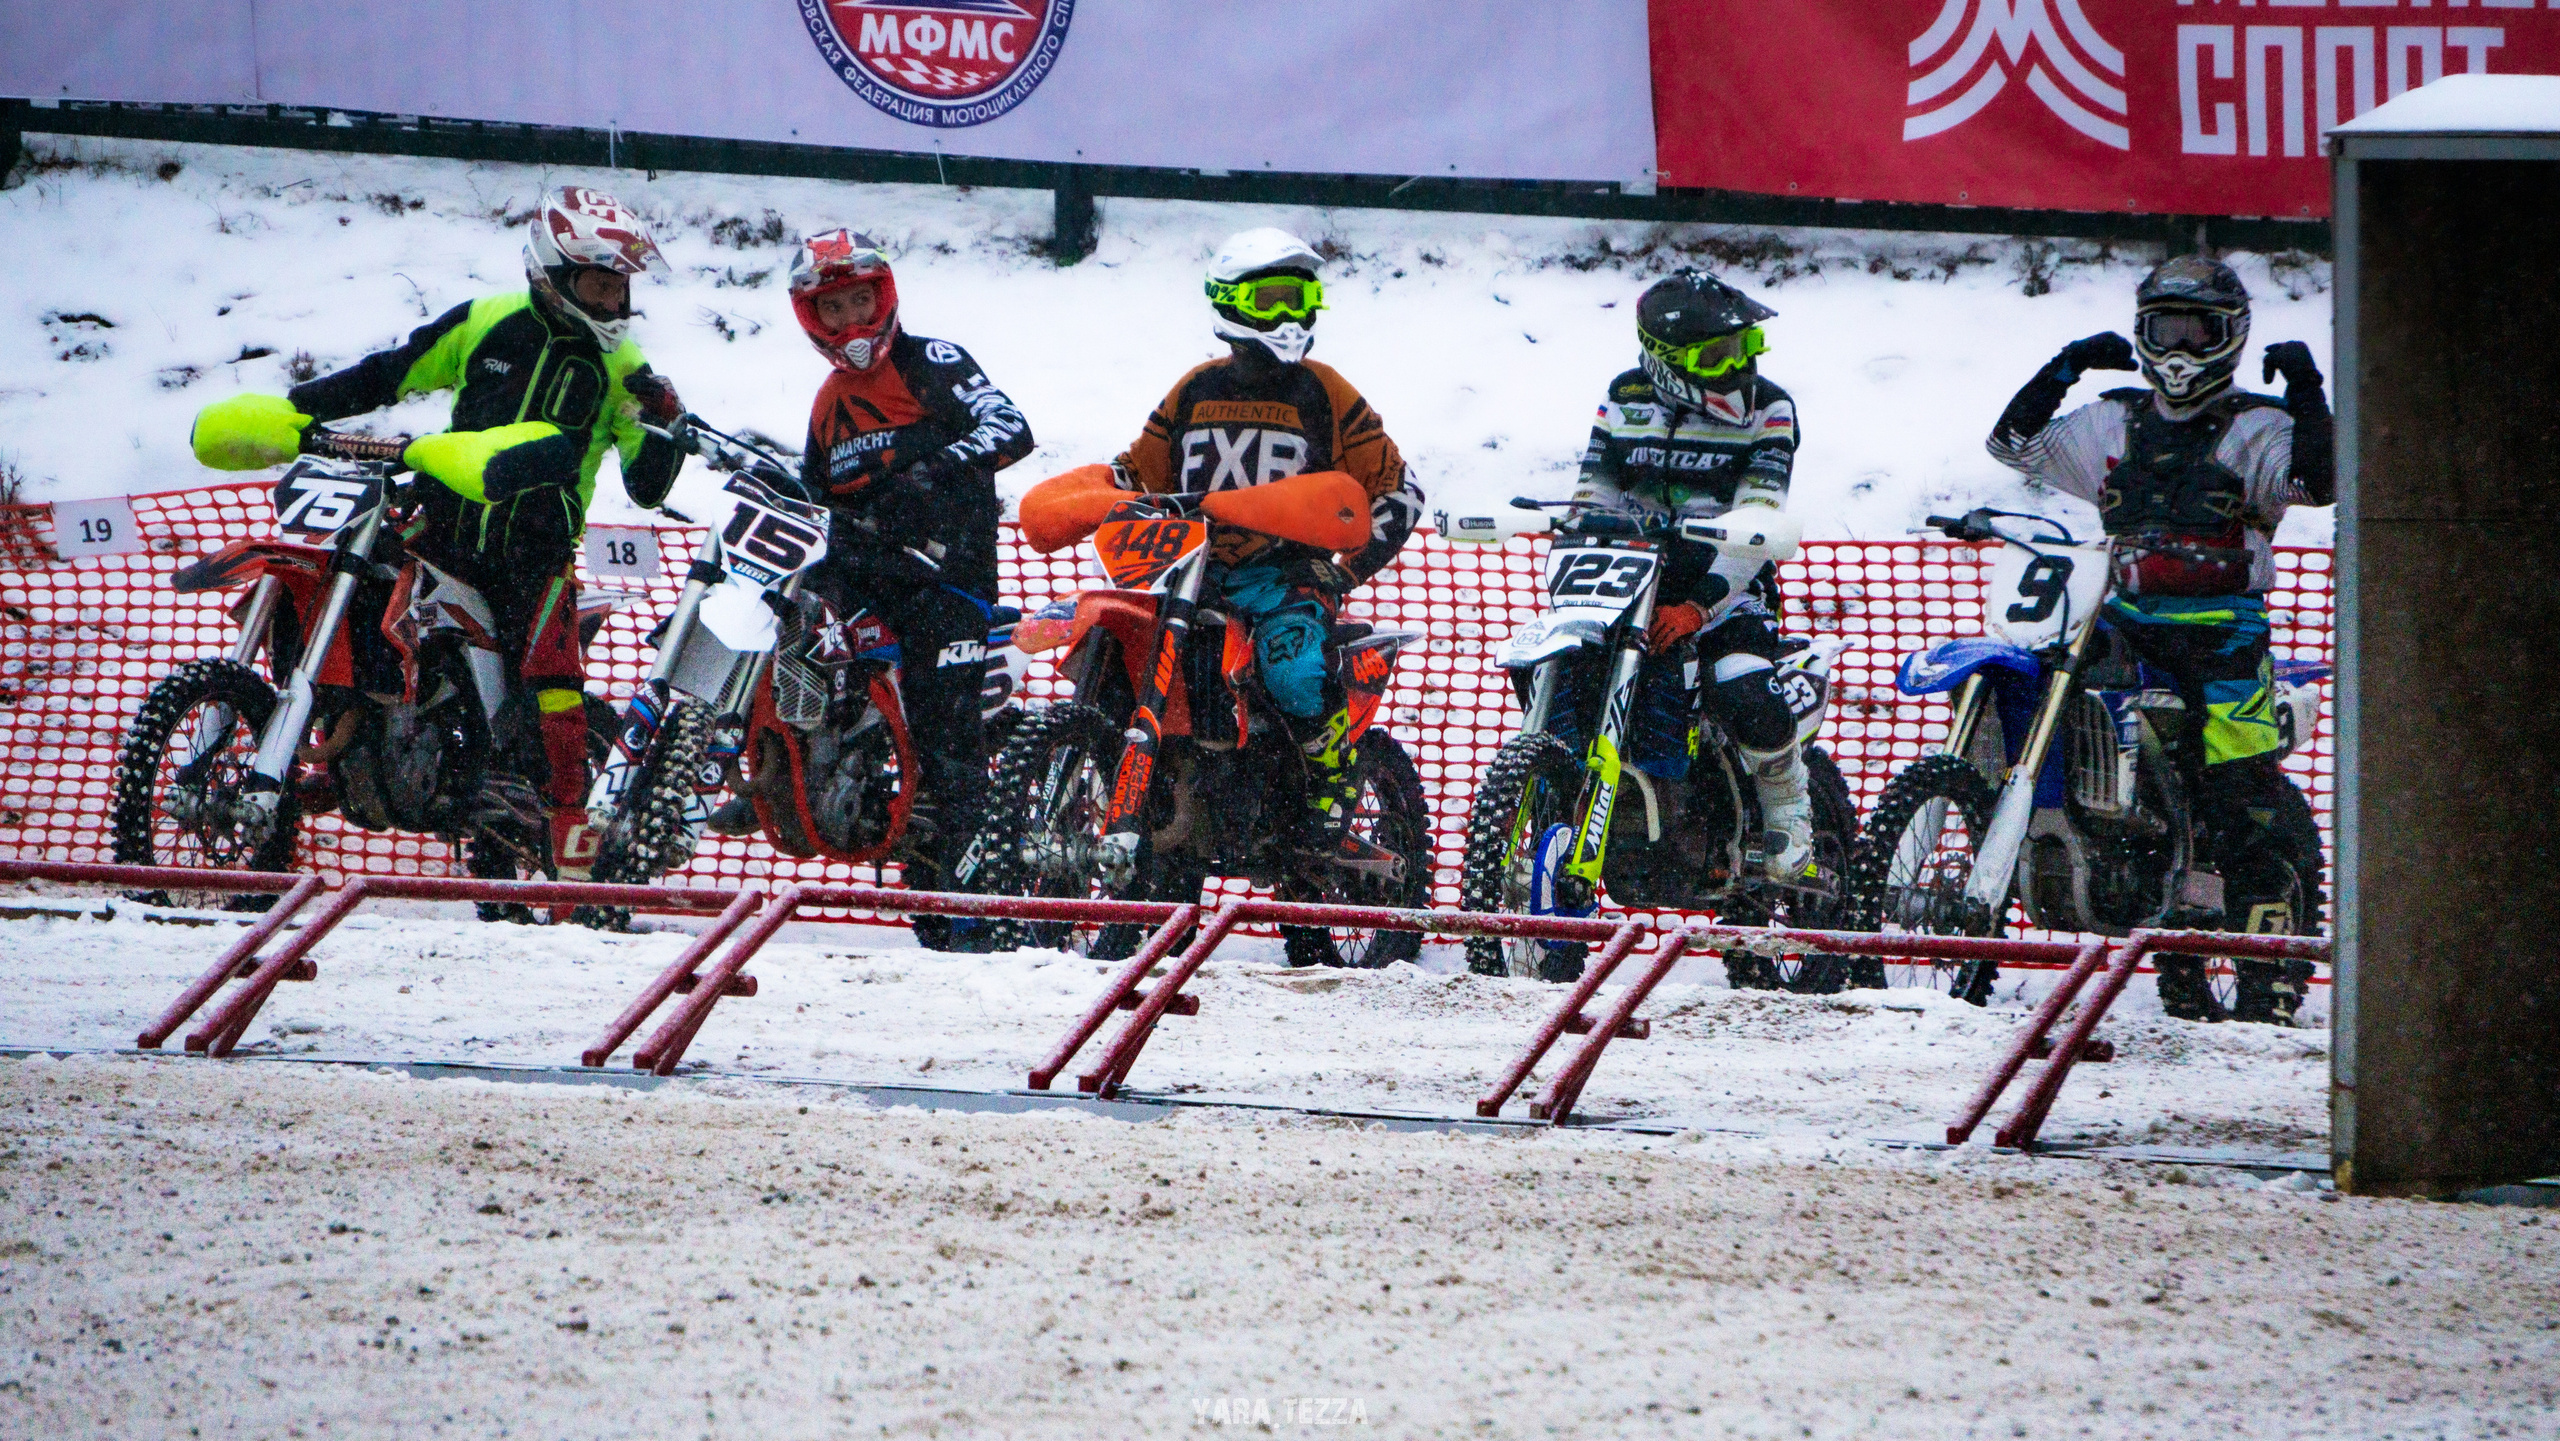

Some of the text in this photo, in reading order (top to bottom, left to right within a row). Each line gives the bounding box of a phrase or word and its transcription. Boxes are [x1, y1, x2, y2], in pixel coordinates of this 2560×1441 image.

[858, 13, 1016, 63] МФМС
[844, 65, 933, 124] ФЕДЕРАЦИЯ
[942, 34, 1059, 125] МОТОЦИКЛЕТНОГО
[1197, 401, 1294, 424] AUTHENTIC
[830, 430, 896, 464] ANARCHY
[279, 477, 368, 530] 75
[79, 518, 112, 543] 19
[722, 500, 819, 572] 15
[1103, 522, 1191, 560] 448
[606, 540, 637, 566] 18
[1550, 553, 1654, 598] 123
[2006, 555, 2075, 623] 9
[937, 640, 986, 668] KTM
[1352, 647, 1389, 684] 448
[1124, 752, 1147, 815] GoPro
